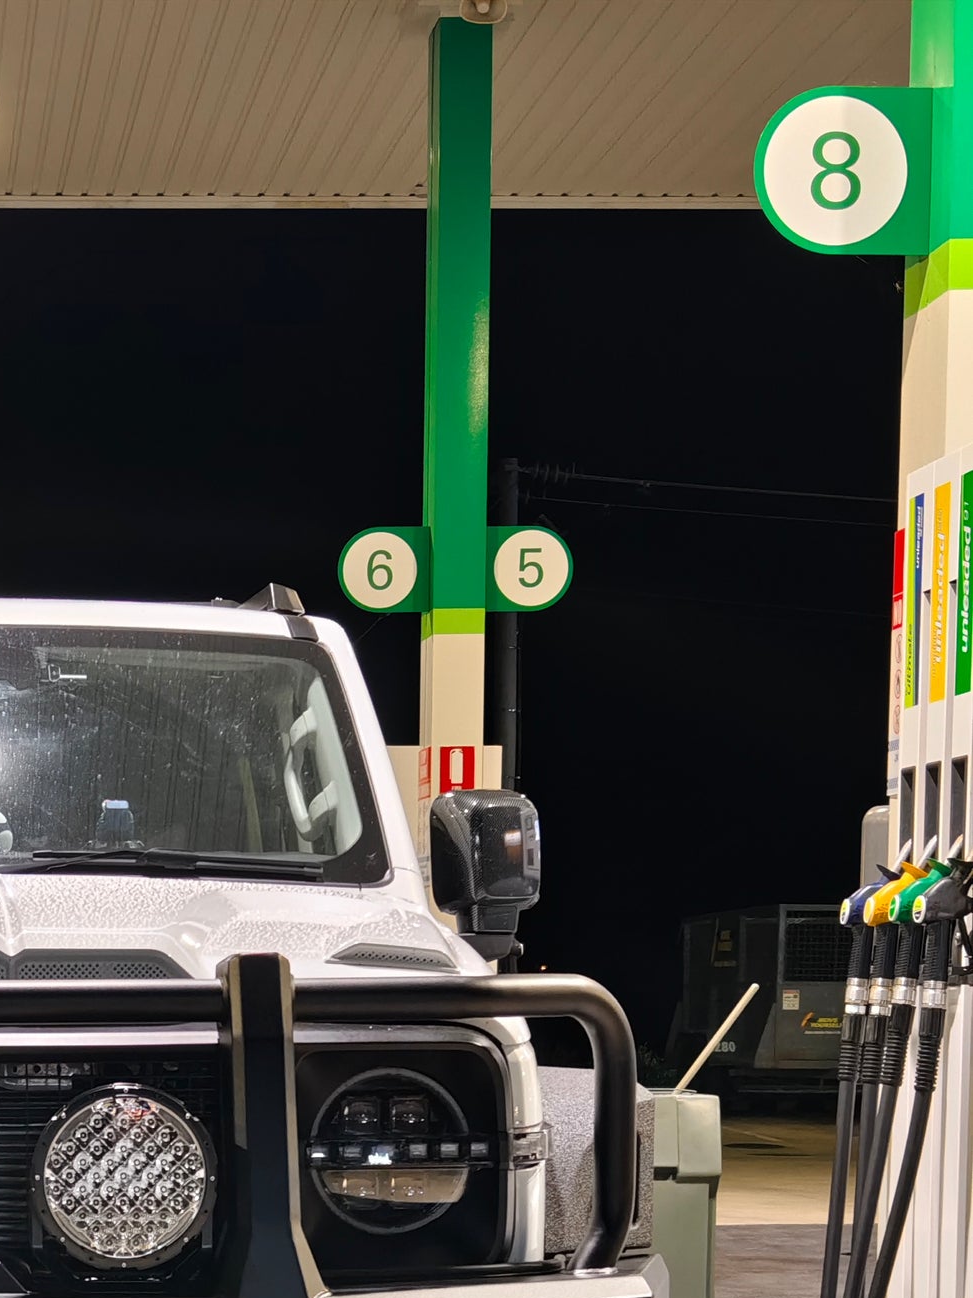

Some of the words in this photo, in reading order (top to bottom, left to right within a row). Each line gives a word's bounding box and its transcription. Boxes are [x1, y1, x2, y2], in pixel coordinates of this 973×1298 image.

[810, 131, 861, 210] 8
[366, 550, 393, 590] 6
[518, 547, 544, 588] 5
[934, 532, 945, 663] unleaded
[961, 525, 972, 653] unleaded
